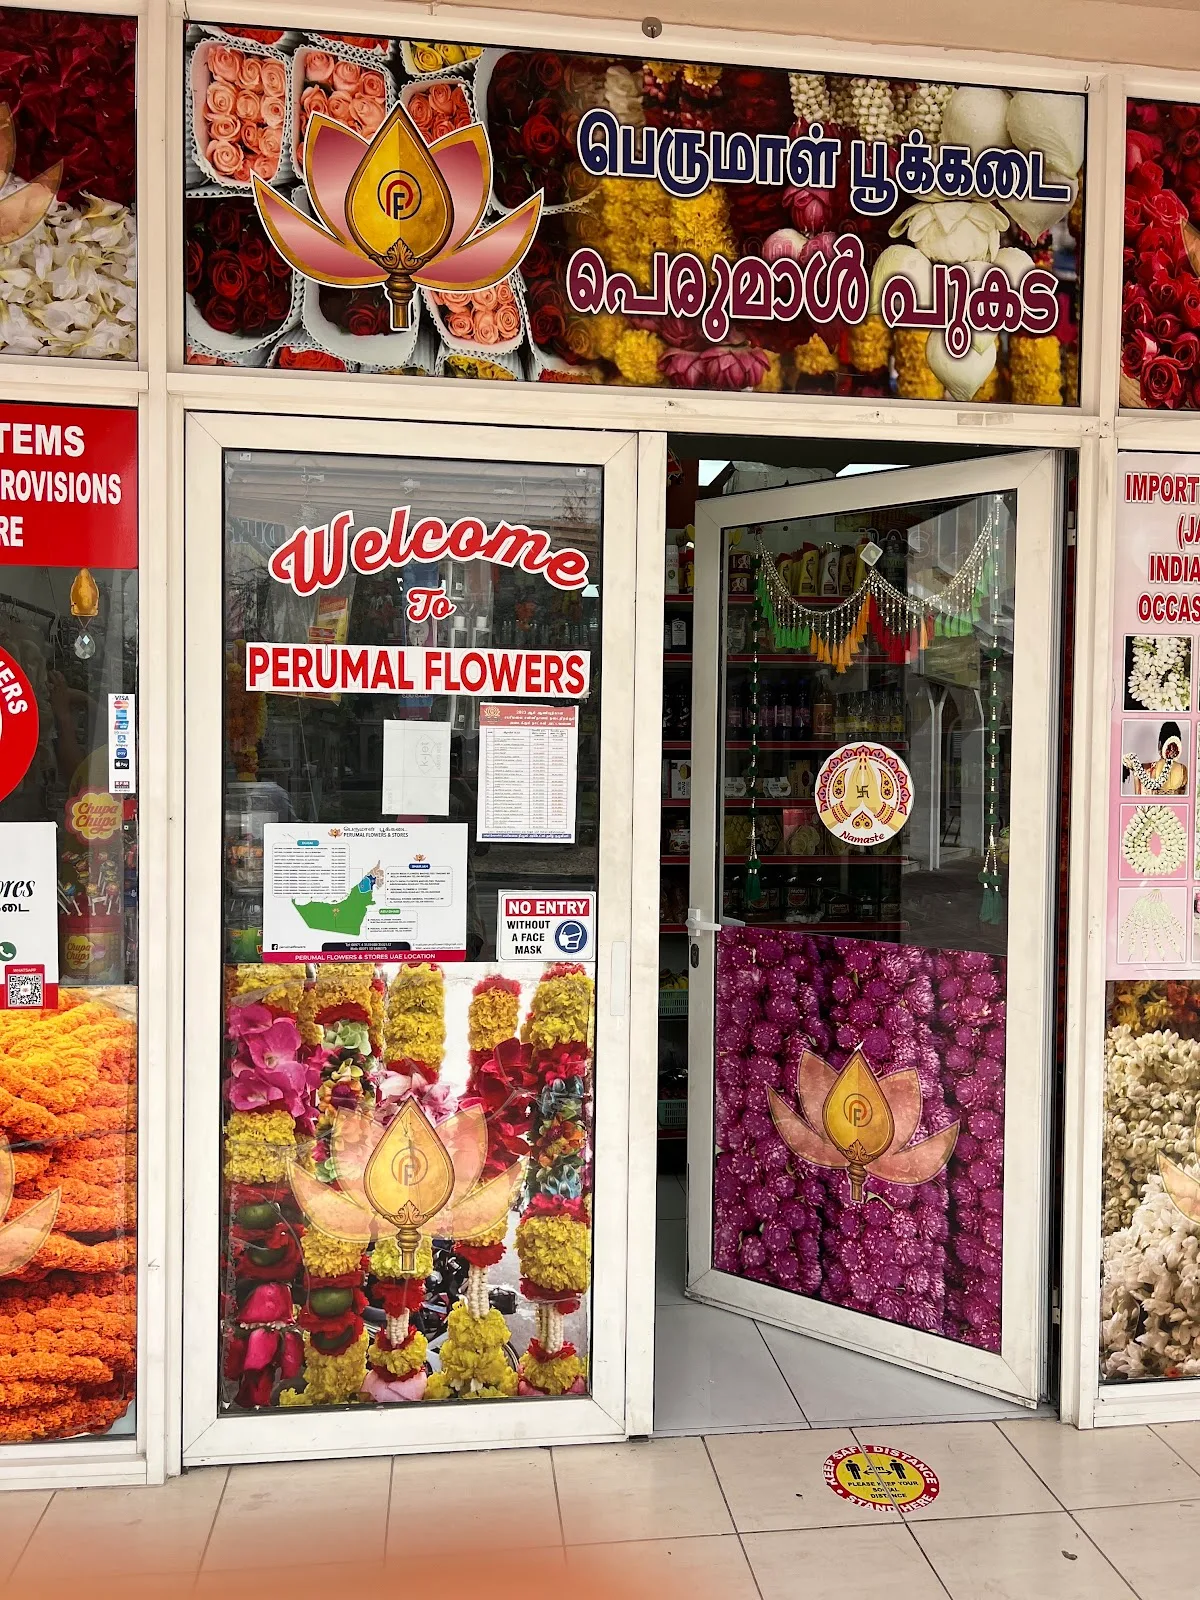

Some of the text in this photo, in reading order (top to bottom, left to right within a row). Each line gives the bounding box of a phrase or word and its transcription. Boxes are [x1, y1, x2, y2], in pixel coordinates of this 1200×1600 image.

[576, 108, 1072, 216] பெருமாள் பூக்கடை
[1, 469, 122, 505] ROVISIONS
[1125, 472, 1200, 504] IMPORT
[268, 505, 590, 597] Welcome
[1148, 553, 1200, 584] INDIA
[406, 587, 456, 623] To
[249, 647, 586, 694] PERUMAL FLOWERS
[0, 661, 28, 714] ERS
[78, 802, 118, 817] Chupa
[76, 814, 117, 834] Chups
[839, 831, 885, 844] Namaste
[0, 903, 30, 913] டை
[508, 901, 587, 915] NO ENTRY
[507, 920, 550, 929] WITHOUT
[511, 933, 545, 942] A FACE
[515, 945, 542, 954] MASK
[873, 1446, 937, 1484] DISTANCE
[847, 1493, 934, 1512] STAND HERE
